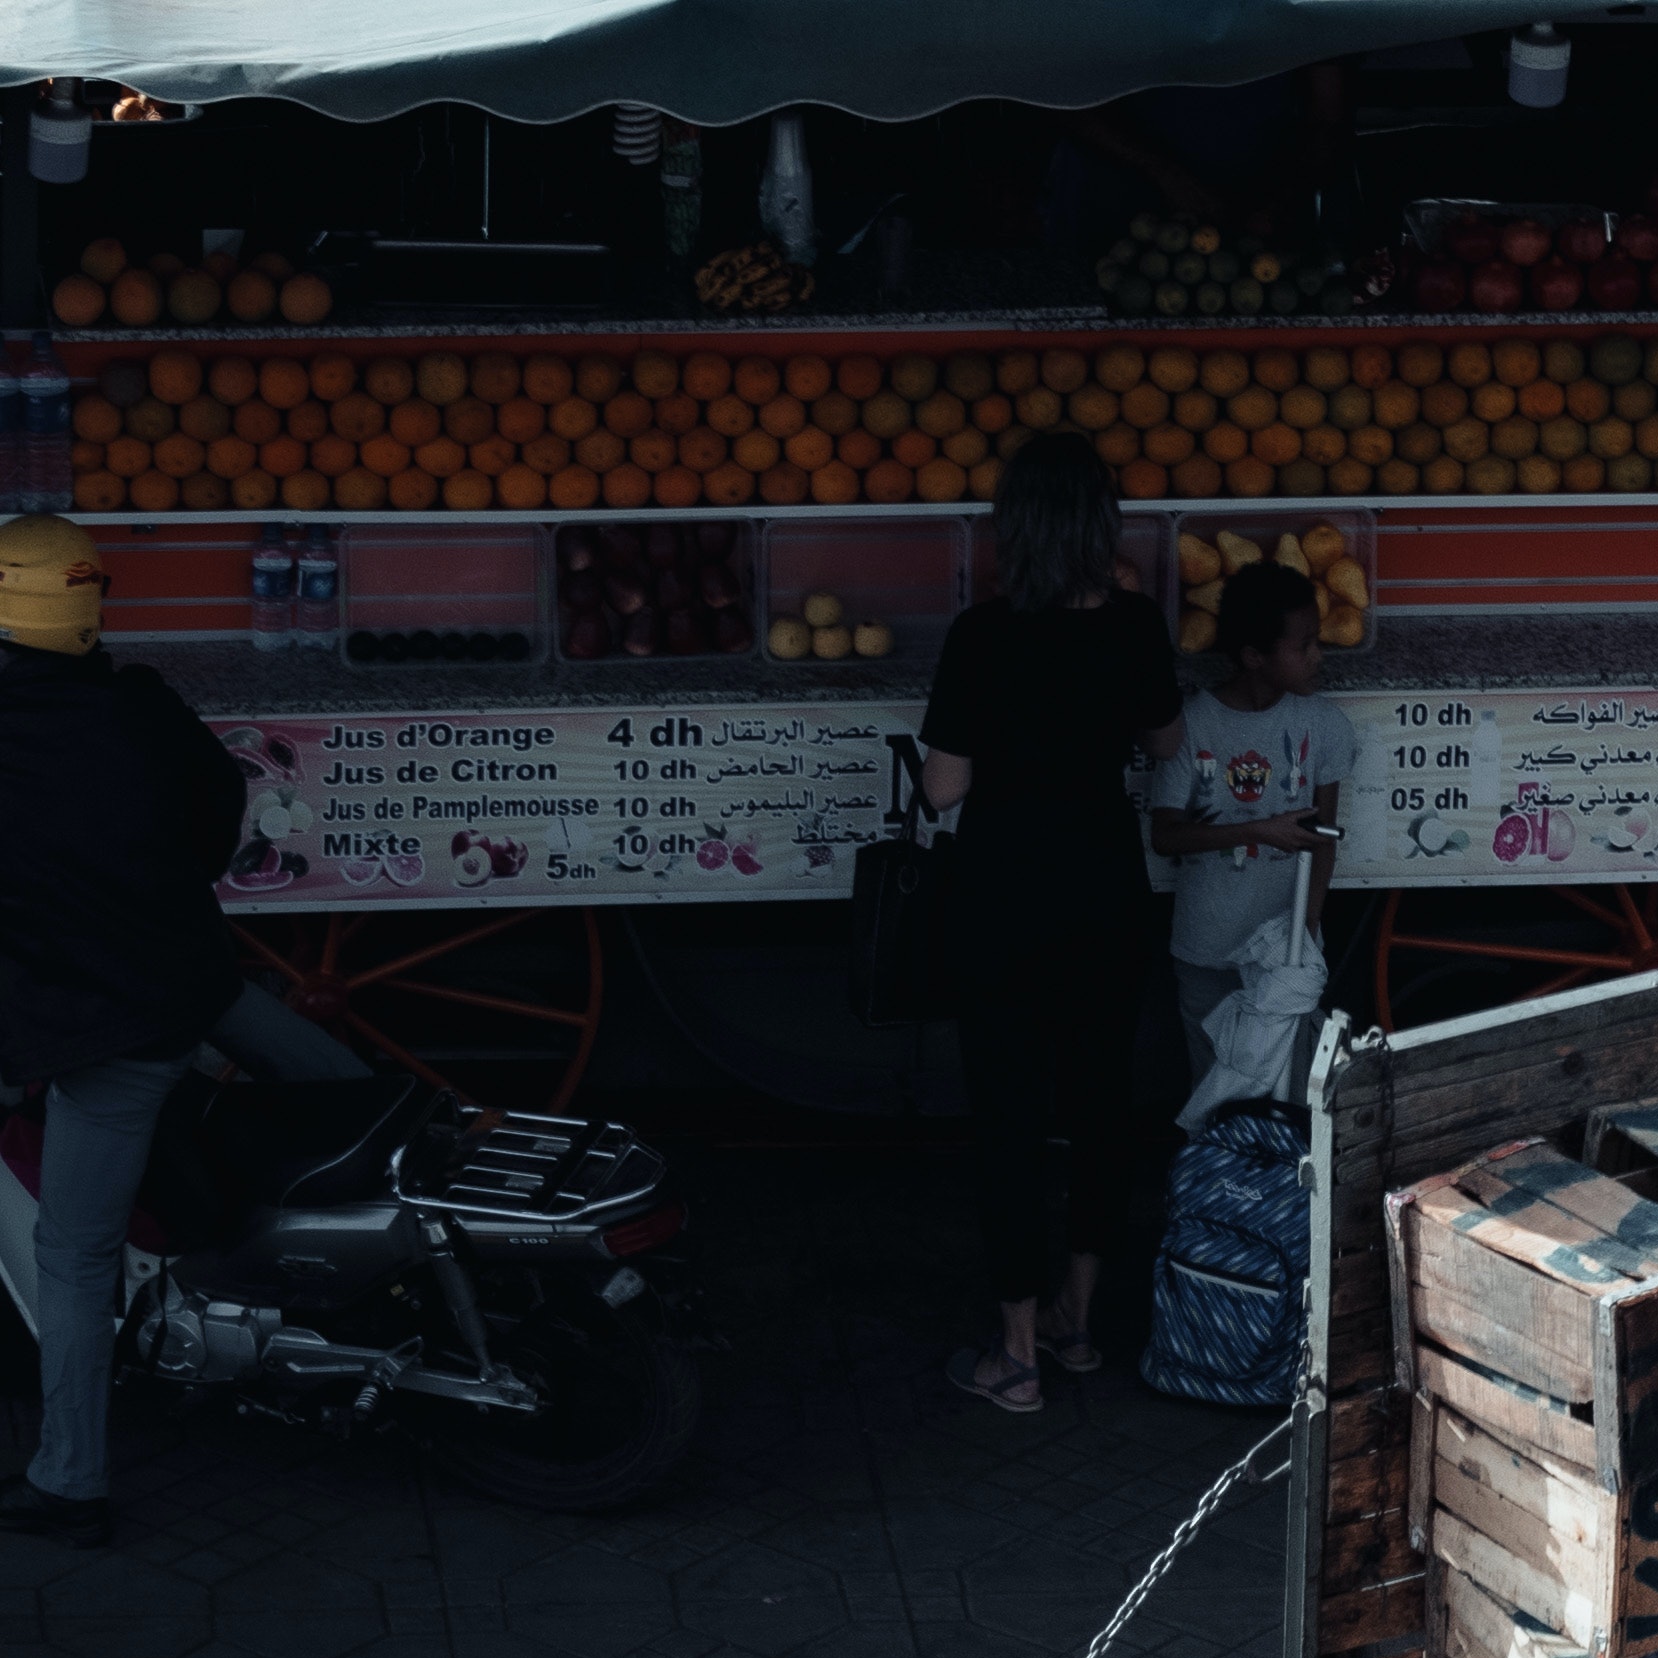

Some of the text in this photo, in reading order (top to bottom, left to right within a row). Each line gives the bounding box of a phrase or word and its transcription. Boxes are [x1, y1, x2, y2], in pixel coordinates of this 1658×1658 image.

[1395, 703, 1473, 727] 10 dh
[1532, 701, 1624, 731] الفواكه
[323, 726, 385, 749] Jus
[607, 718, 703, 747] 4 dh
[710, 719, 881, 748] عصير البرتقال
[613, 759, 697, 781] 10 dh
[706, 755, 880, 783] عصير الحامض
[1393, 745, 1471, 769] 10 dh
[1512, 744, 1577, 772] كبير
[1580, 744, 1652, 775] معدني
[323, 759, 558, 785] Jus de Citron
[323, 795, 600, 823] Jus de Pamplemousse
[613, 797, 697, 818] 10 dh
[819, 791, 879, 814] عصير
[1390, 787, 1426, 812] 05
[1434, 787, 1469, 810] dh
[1515, 780, 1575, 812] صغير
[1578, 784, 1650, 817] معدني
[323, 834, 421, 857] Mixte
[612, 834, 697, 856] 10 dh
